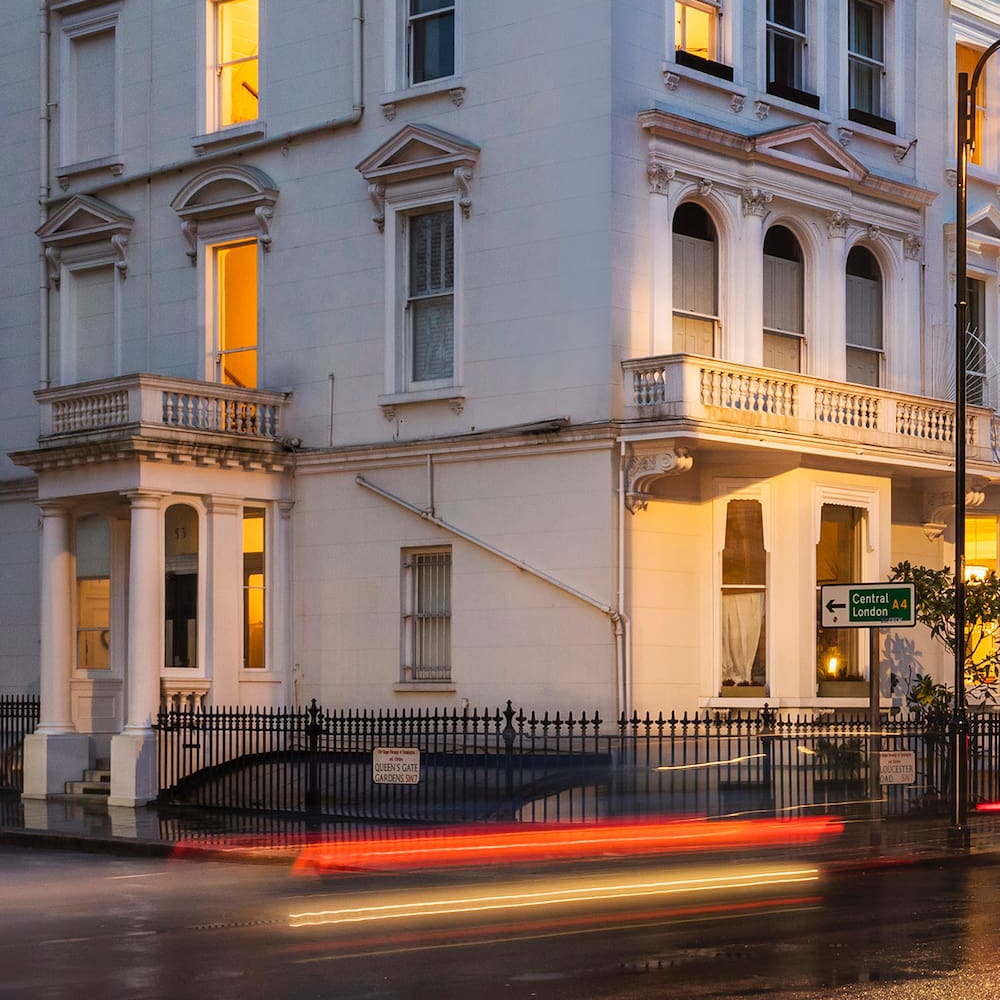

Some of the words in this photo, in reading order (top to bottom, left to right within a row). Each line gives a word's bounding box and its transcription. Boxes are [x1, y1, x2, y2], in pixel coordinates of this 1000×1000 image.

[852, 592, 889, 604] Central
[892, 599, 908, 609] A4
[852, 606, 889, 617] London
[375, 763, 401, 773] QUEEN'S
[401, 763, 418, 773] GATE
[880, 764, 914, 774] LOUCESTER
[880, 774, 894, 783] OAD
